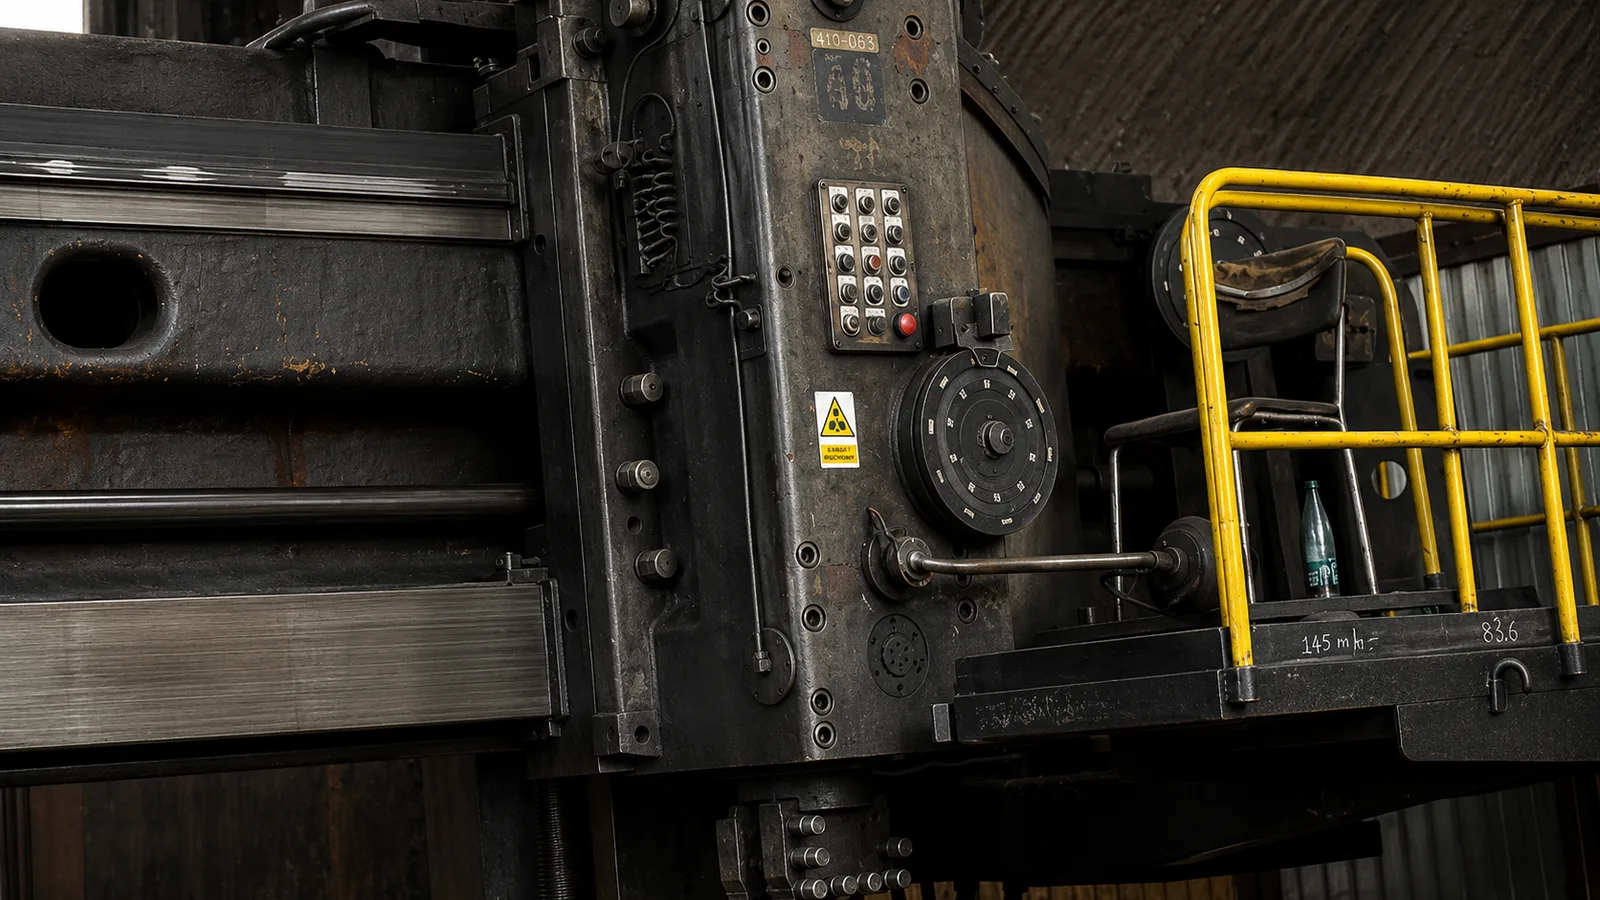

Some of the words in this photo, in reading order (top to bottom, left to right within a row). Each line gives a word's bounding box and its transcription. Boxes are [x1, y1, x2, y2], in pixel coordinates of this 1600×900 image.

[816, 32, 875, 50] 410-063
[1481, 616, 1519, 643] 83.6
[1302, 633, 1331, 654] 145
